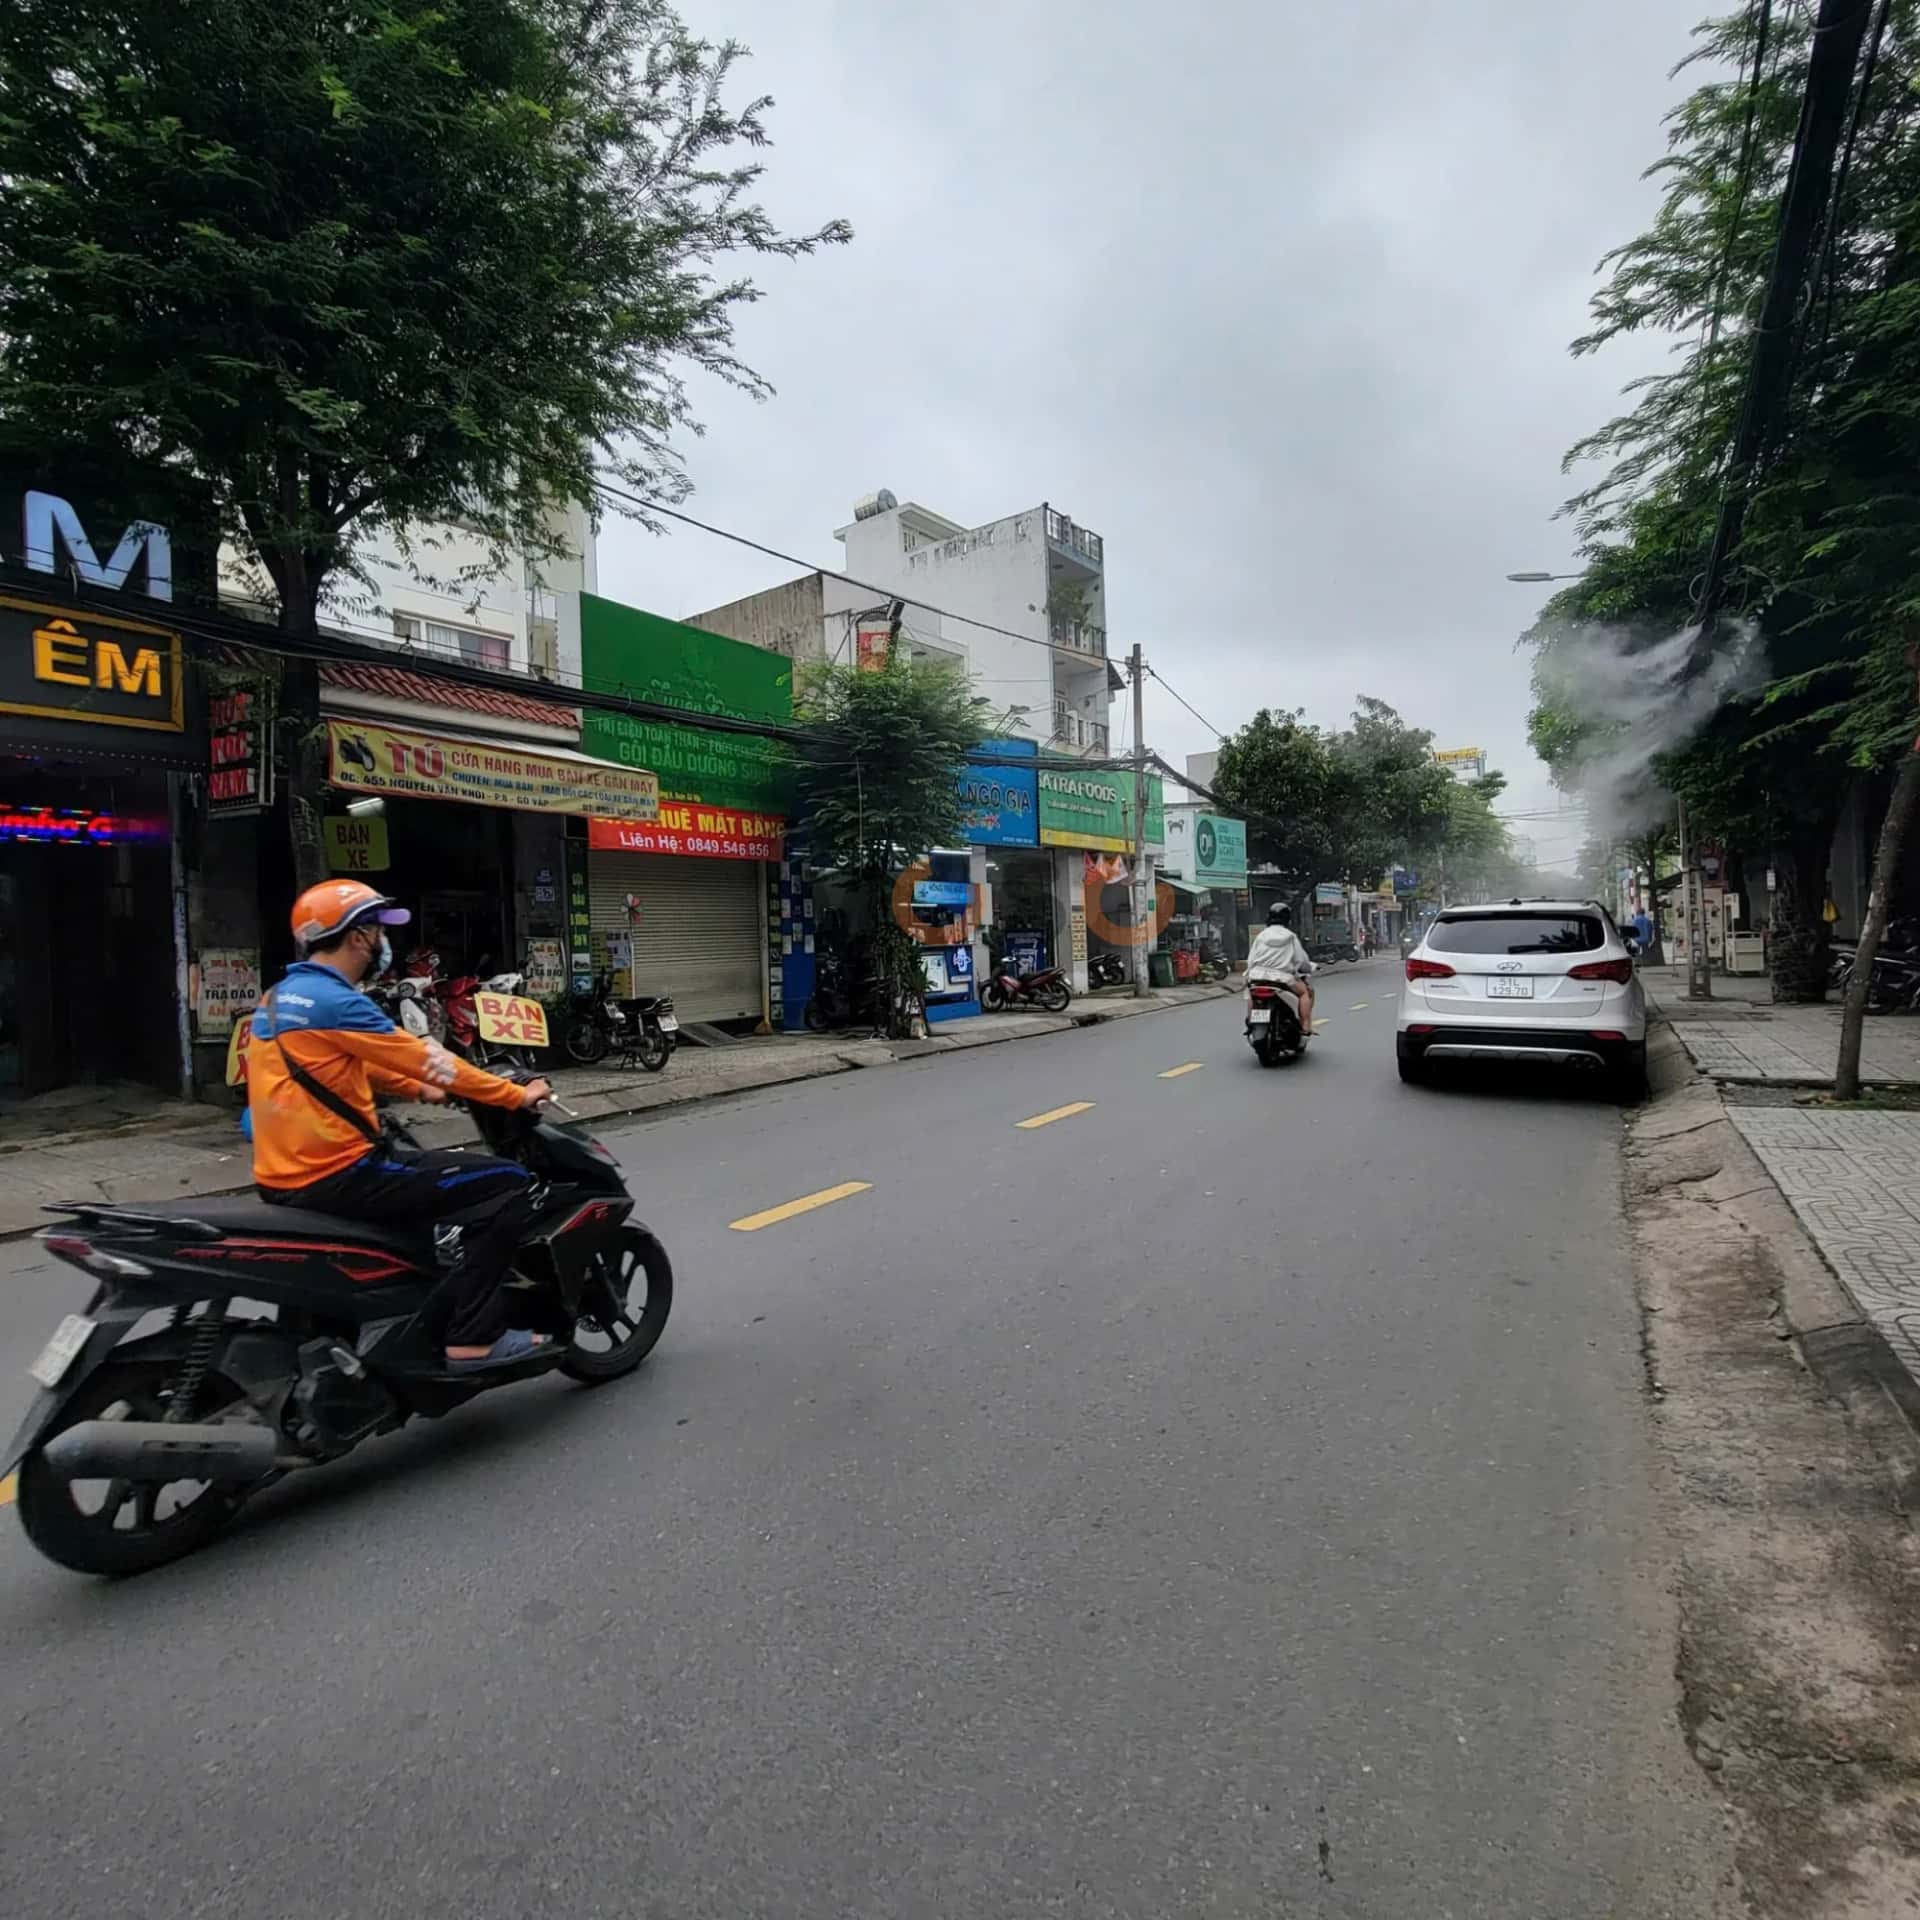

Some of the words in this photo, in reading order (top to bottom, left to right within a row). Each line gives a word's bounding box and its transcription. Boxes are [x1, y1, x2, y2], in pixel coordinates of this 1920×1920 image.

[33, 618, 162, 698] ÊM
[384, 741, 445, 779] TÚ
[526, 763, 554, 780] MUA
[620, 831, 655, 849] Liên
[658, 834, 684, 854] Hệ:
[687, 836, 770, 858] 0849.546.856
[1498, 978, 1520, 987] 51L
[482, 998, 543, 1023] BÁN
[491, 1021, 545, 1043] XE
